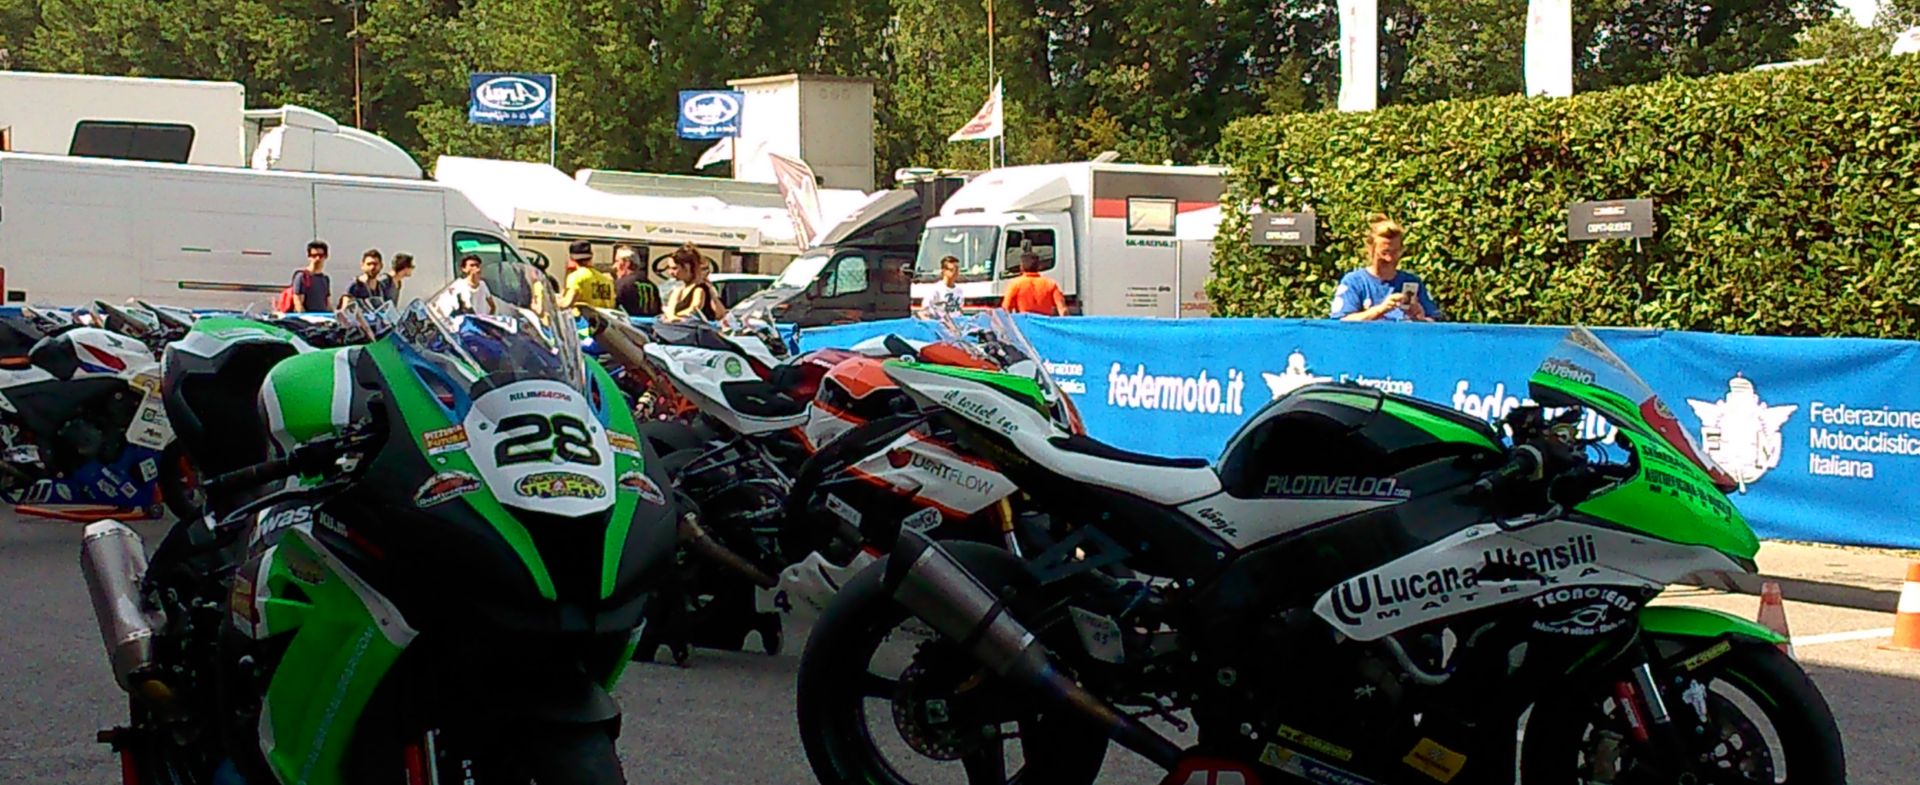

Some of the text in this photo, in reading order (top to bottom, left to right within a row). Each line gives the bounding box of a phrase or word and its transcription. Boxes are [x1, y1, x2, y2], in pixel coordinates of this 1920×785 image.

[1107, 362, 1244, 415] federmoto.it
[1340, 373, 1413, 396] Fderazione
[1809, 401, 1920, 429] Federazione
[493, 413, 602, 467] 28
[1809, 427, 1920, 455] Motociclistica
[1809, 453, 1873, 479] Italiana
[1373, 563, 1478, 607] Lucana
[1482, 534, 1597, 575] Utensili
